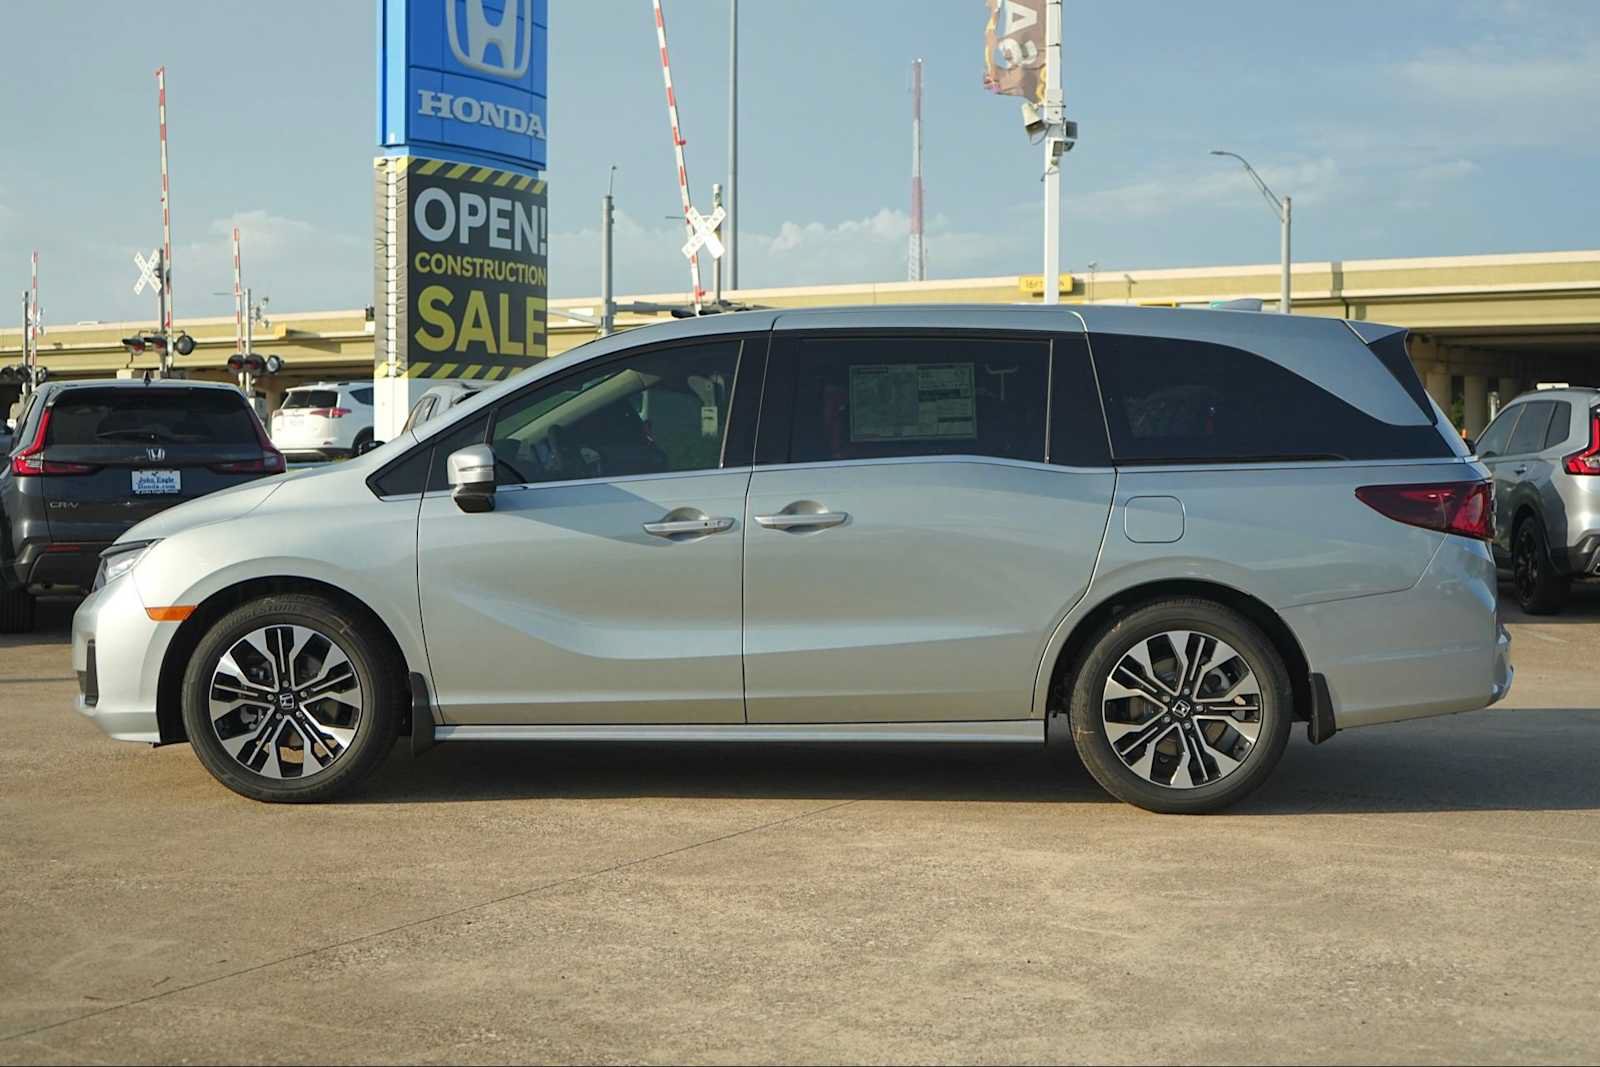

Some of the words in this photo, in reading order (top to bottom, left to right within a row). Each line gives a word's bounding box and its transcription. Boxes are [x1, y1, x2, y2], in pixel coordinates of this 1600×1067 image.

[417, 89, 547, 140] HONDA
[414, 187, 547, 256] OPEN!
[414, 251, 547, 288] CONSTRUCTION
[414, 285, 547, 358] SALE
